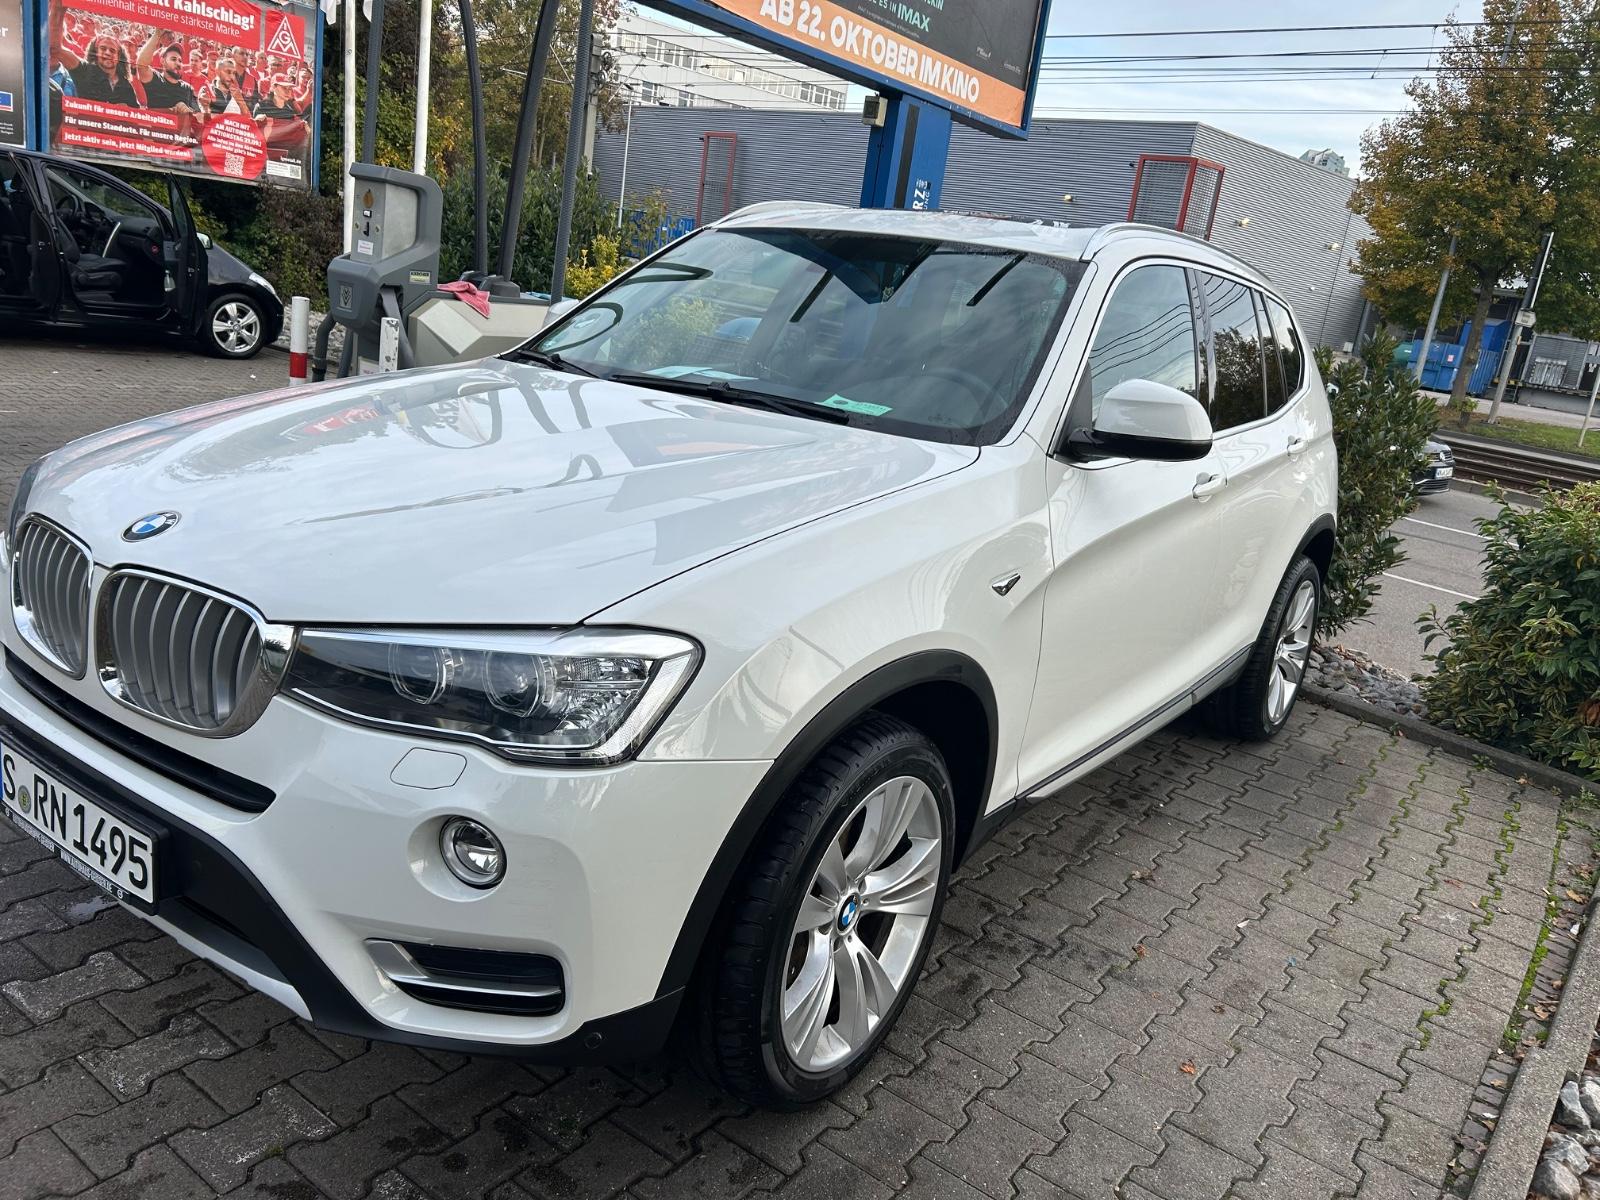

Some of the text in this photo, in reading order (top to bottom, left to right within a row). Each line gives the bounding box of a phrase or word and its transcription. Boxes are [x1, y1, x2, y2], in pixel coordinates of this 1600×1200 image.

[137, 4, 149, 16] ist
[150, 8, 179, 24] unsere
[175, 0, 255, 30] Kahlschlag!
[897, 3, 931, 33] IMAX
[760, 0, 795, 26] AB
[796, 0, 826, 41] 22.
[830, 15, 919, 79] OKTOBER
[918, 54, 942, 89] IM
[941, 66, 980, 103] KINO
[64, 100, 93, 111] Zukunft
[94, 105, 104, 113] für
[106, 108, 129, 117] unsere
[64, 116, 199, 144] Für unsere Standorte. Für unsere Region.
[82, 134, 101, 144] aktiv
[3, 753, 16, 801] S
